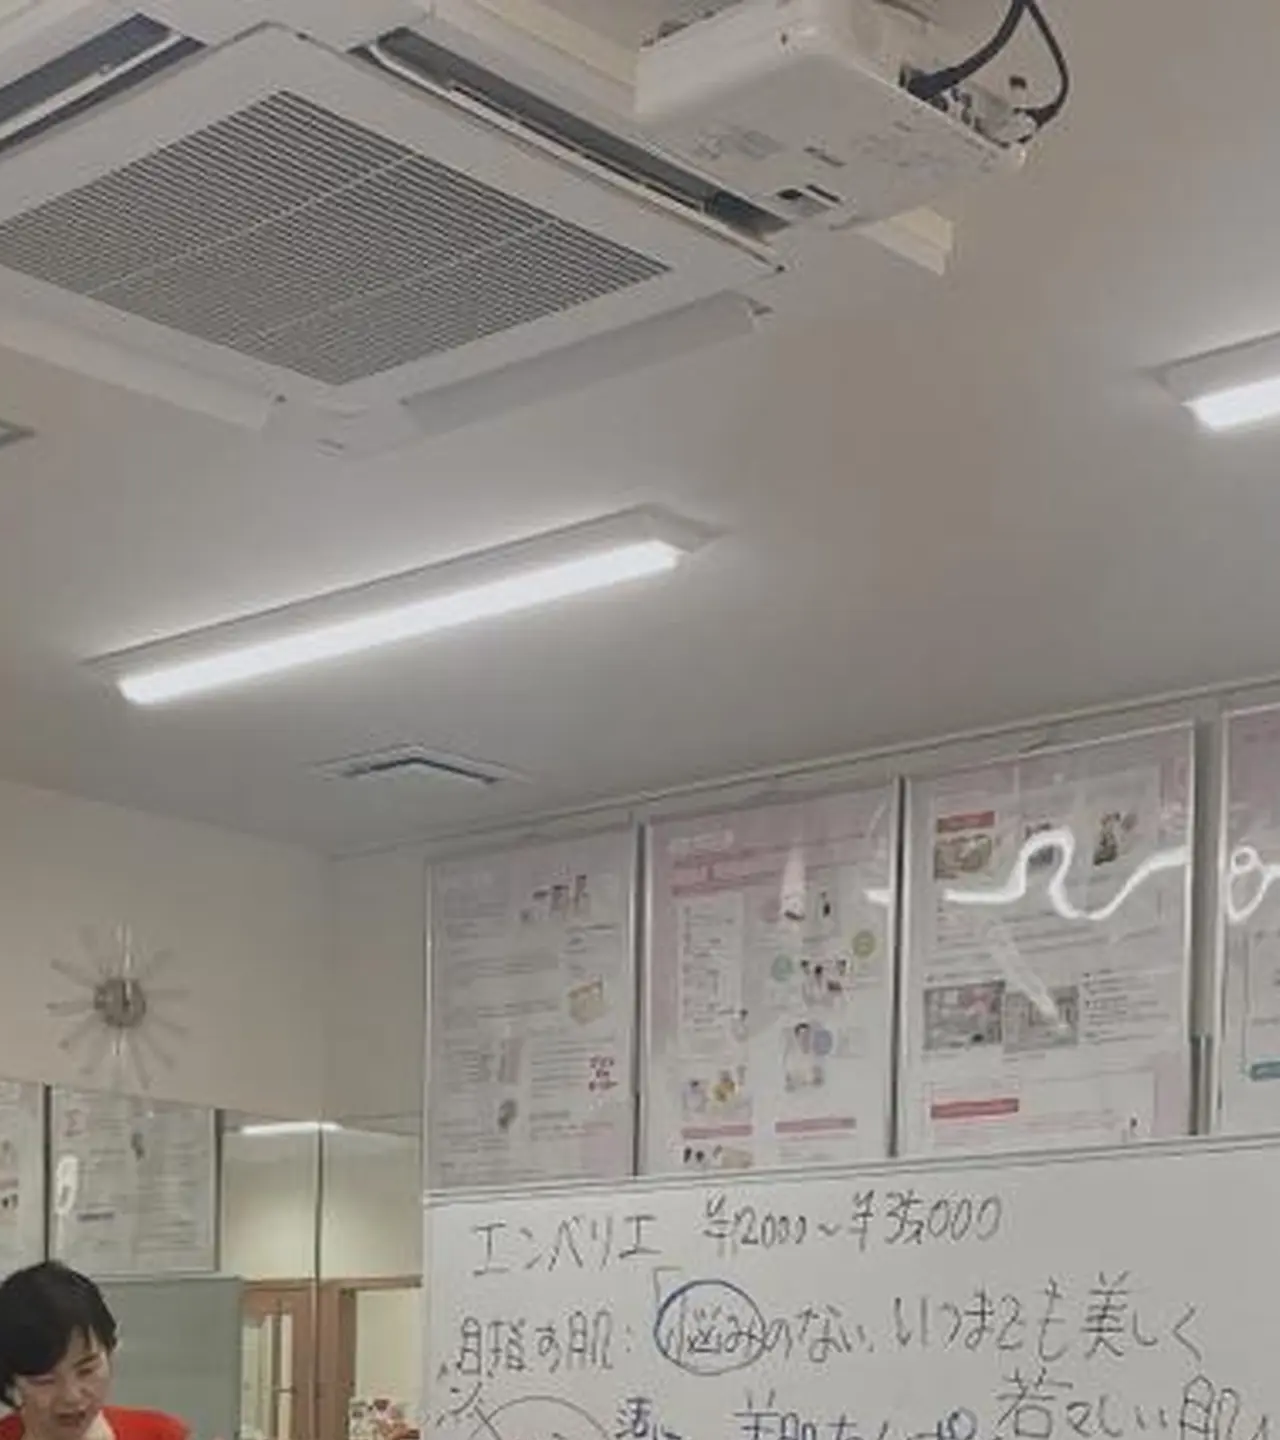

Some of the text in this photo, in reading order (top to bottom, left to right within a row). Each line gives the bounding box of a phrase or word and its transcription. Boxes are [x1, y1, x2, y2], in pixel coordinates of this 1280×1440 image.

[471, 1214, 662, 1276] エンベリエ
